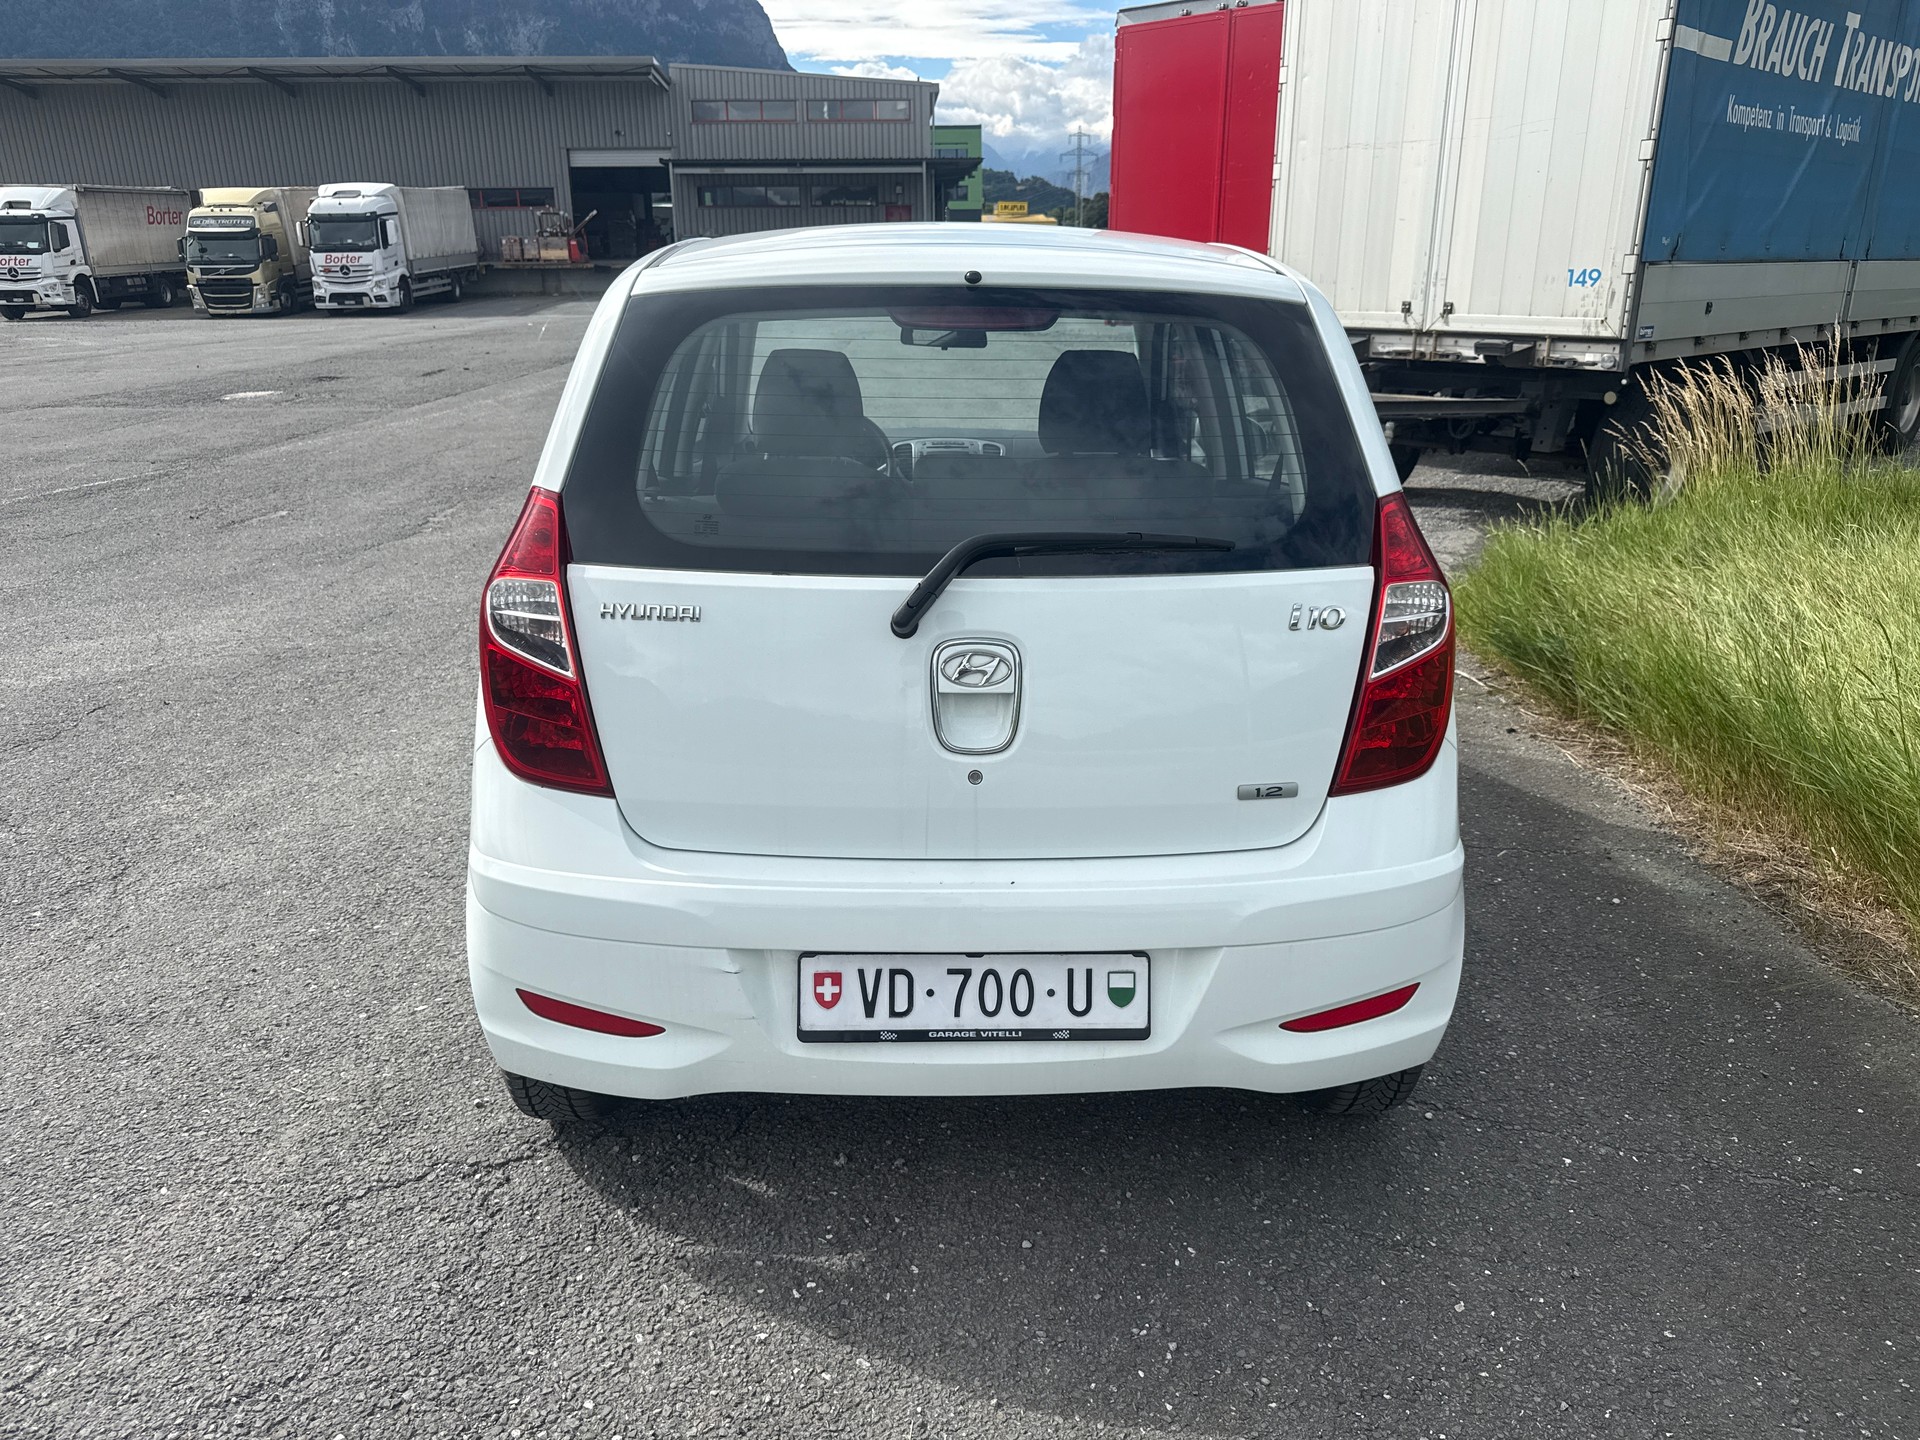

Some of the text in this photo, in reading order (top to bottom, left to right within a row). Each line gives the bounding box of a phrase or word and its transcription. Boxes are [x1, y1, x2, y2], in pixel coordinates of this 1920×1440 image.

[1733, 0, 1834, 83] BRAUCH
[1727, 94, 1861, 146] Kompetenz in Transport & Logistik
[147, 205, 183, 225] Borter
[0, 256, 32, 266] orter
[324, 254, 363, 264] Borter
[1567, 268, 1602, 287] 149
[600, 603, 701, 622] HYUNDAI
[1288, 603, 1347, 631] i10
[1255, 786, 1283, 798] 1.2
